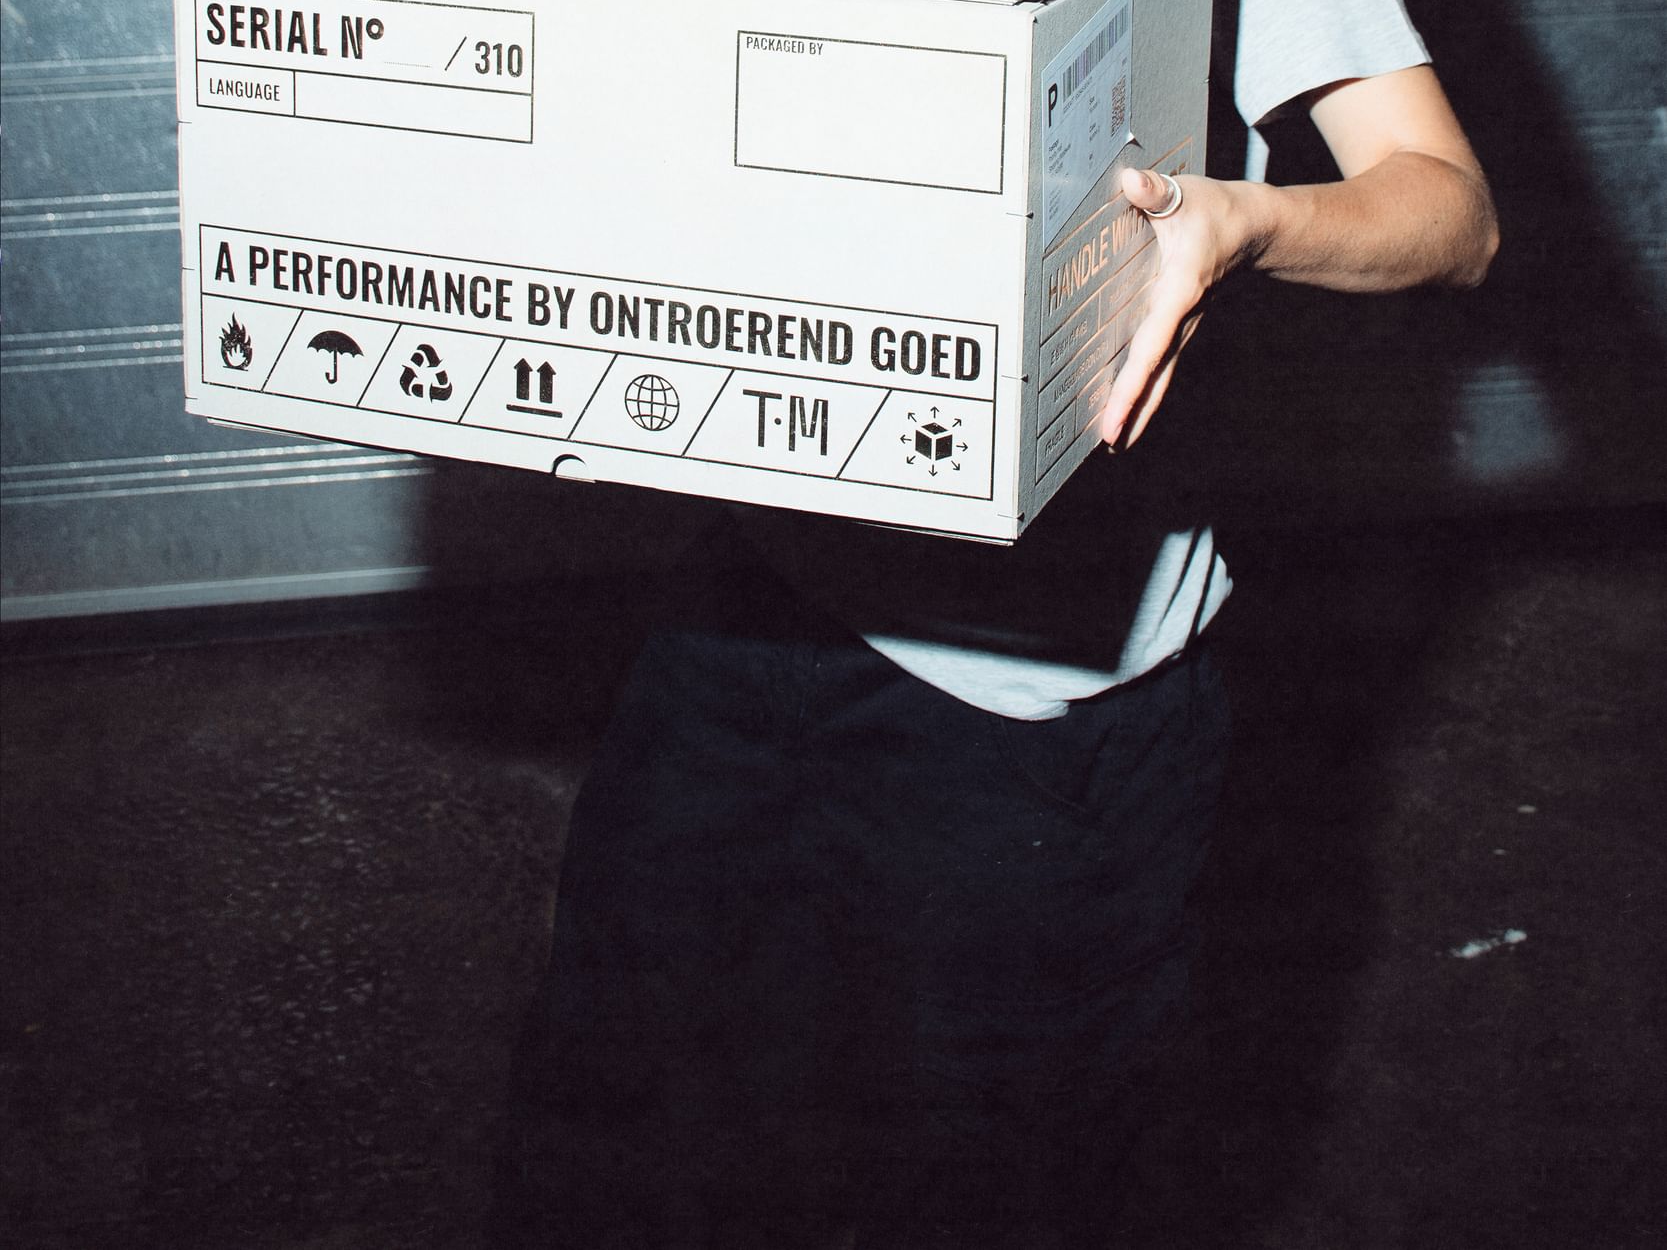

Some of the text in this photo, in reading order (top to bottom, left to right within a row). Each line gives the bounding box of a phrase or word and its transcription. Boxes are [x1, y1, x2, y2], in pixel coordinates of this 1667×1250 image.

[206, 2, 328, 57] SERIAL
[475, 40, 523, 78] 310
[746, 36, 823, 55] PACKAGED BY
[209, 77, 281, 102] LANGUAGE
[1048, 82, 1058, 128] P
[1047, 225, 1109, 317] HANDLE
[215, 241, 981, 382] A PERFORMANCE BY ONTROEREND GOED
